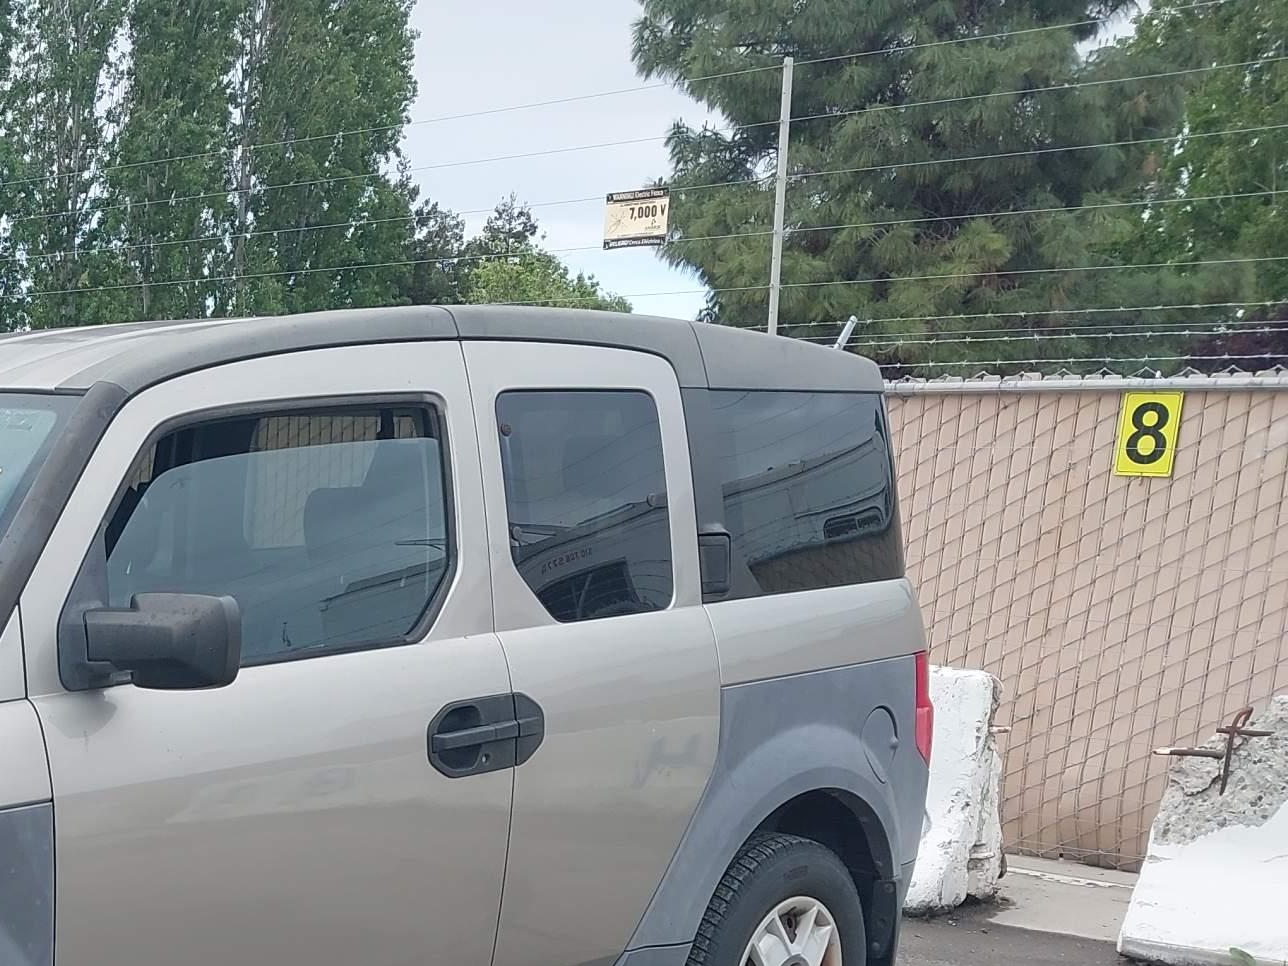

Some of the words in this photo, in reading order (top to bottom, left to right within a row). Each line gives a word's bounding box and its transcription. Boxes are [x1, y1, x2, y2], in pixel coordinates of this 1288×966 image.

[629, 205, 657, 221] 7,000
[660, 204, 666, 216] V
[1125, 401, 1169, 465] 8
